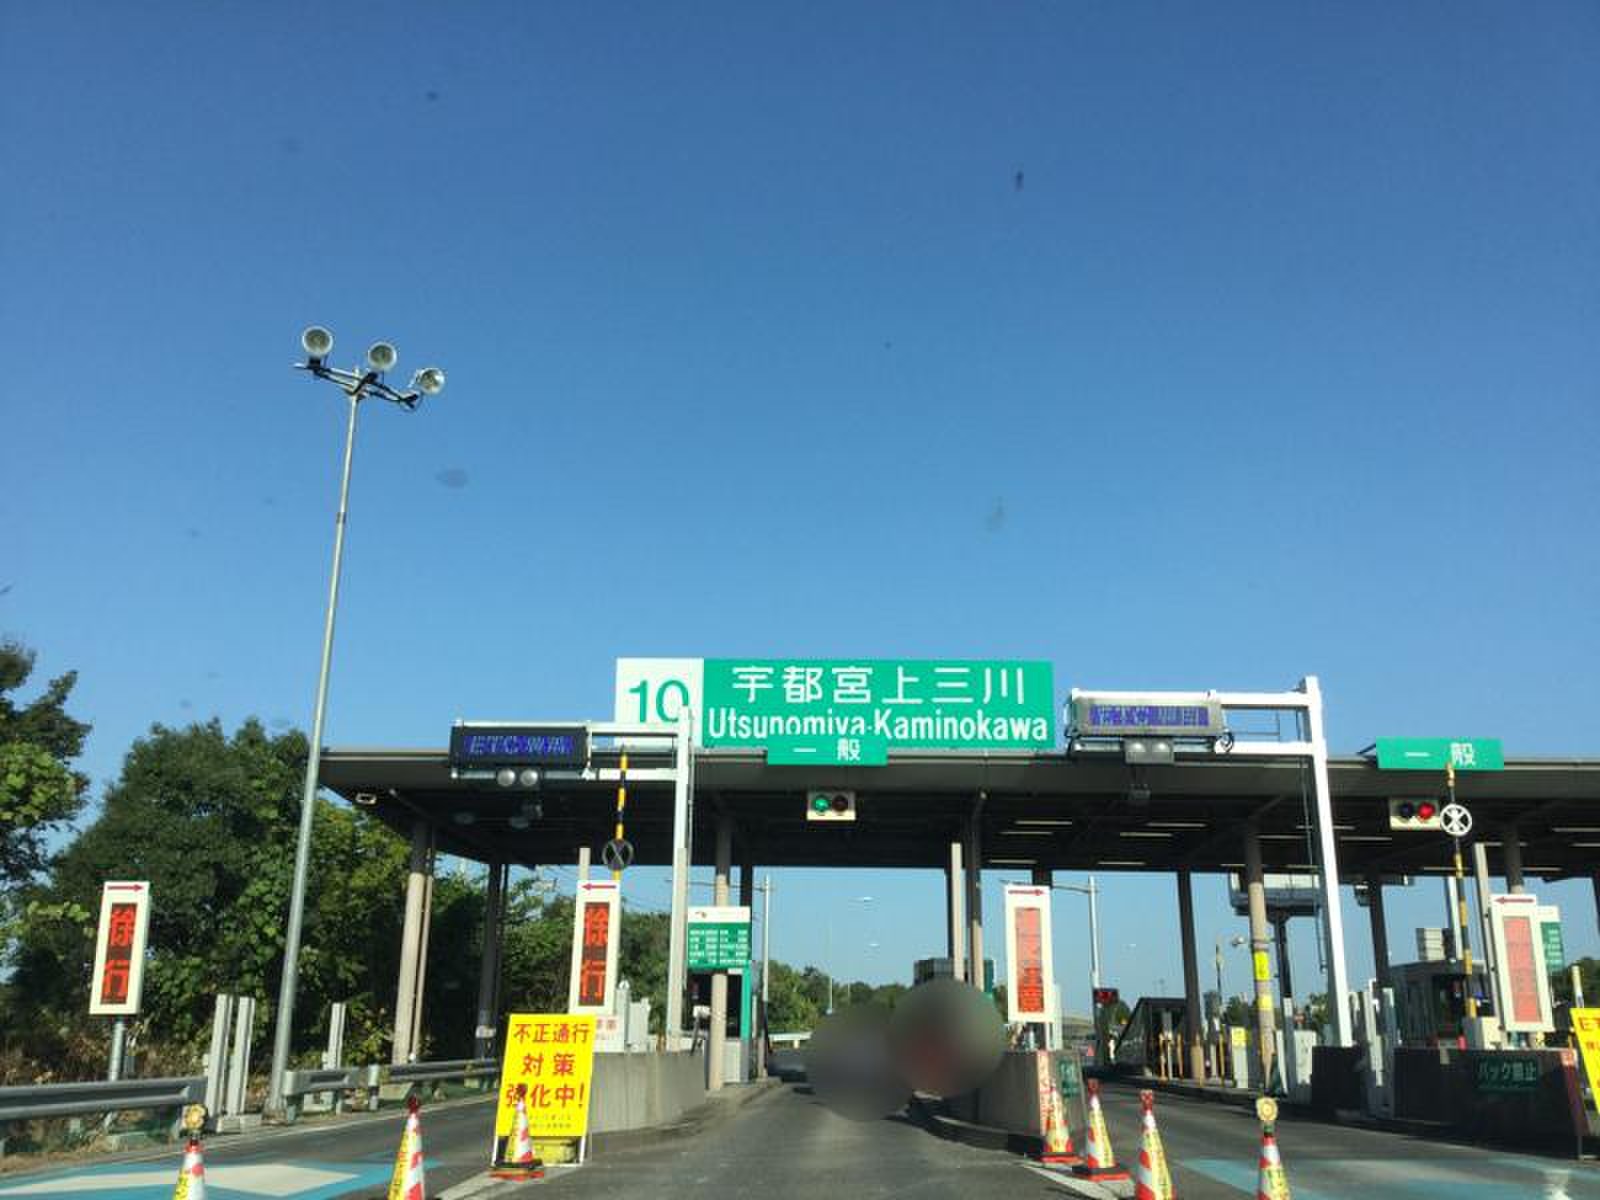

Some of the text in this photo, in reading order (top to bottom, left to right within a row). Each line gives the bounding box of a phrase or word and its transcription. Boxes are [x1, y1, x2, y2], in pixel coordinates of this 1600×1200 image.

[732, 665, 1024, 704] 宇都宮上三川
[629, 680, 689, 723] 10
[793, 737, 861, 761] 一般
[513, 1023, 591, 1043] 不正通行
[521, 1052, 575, 1077] 対策
